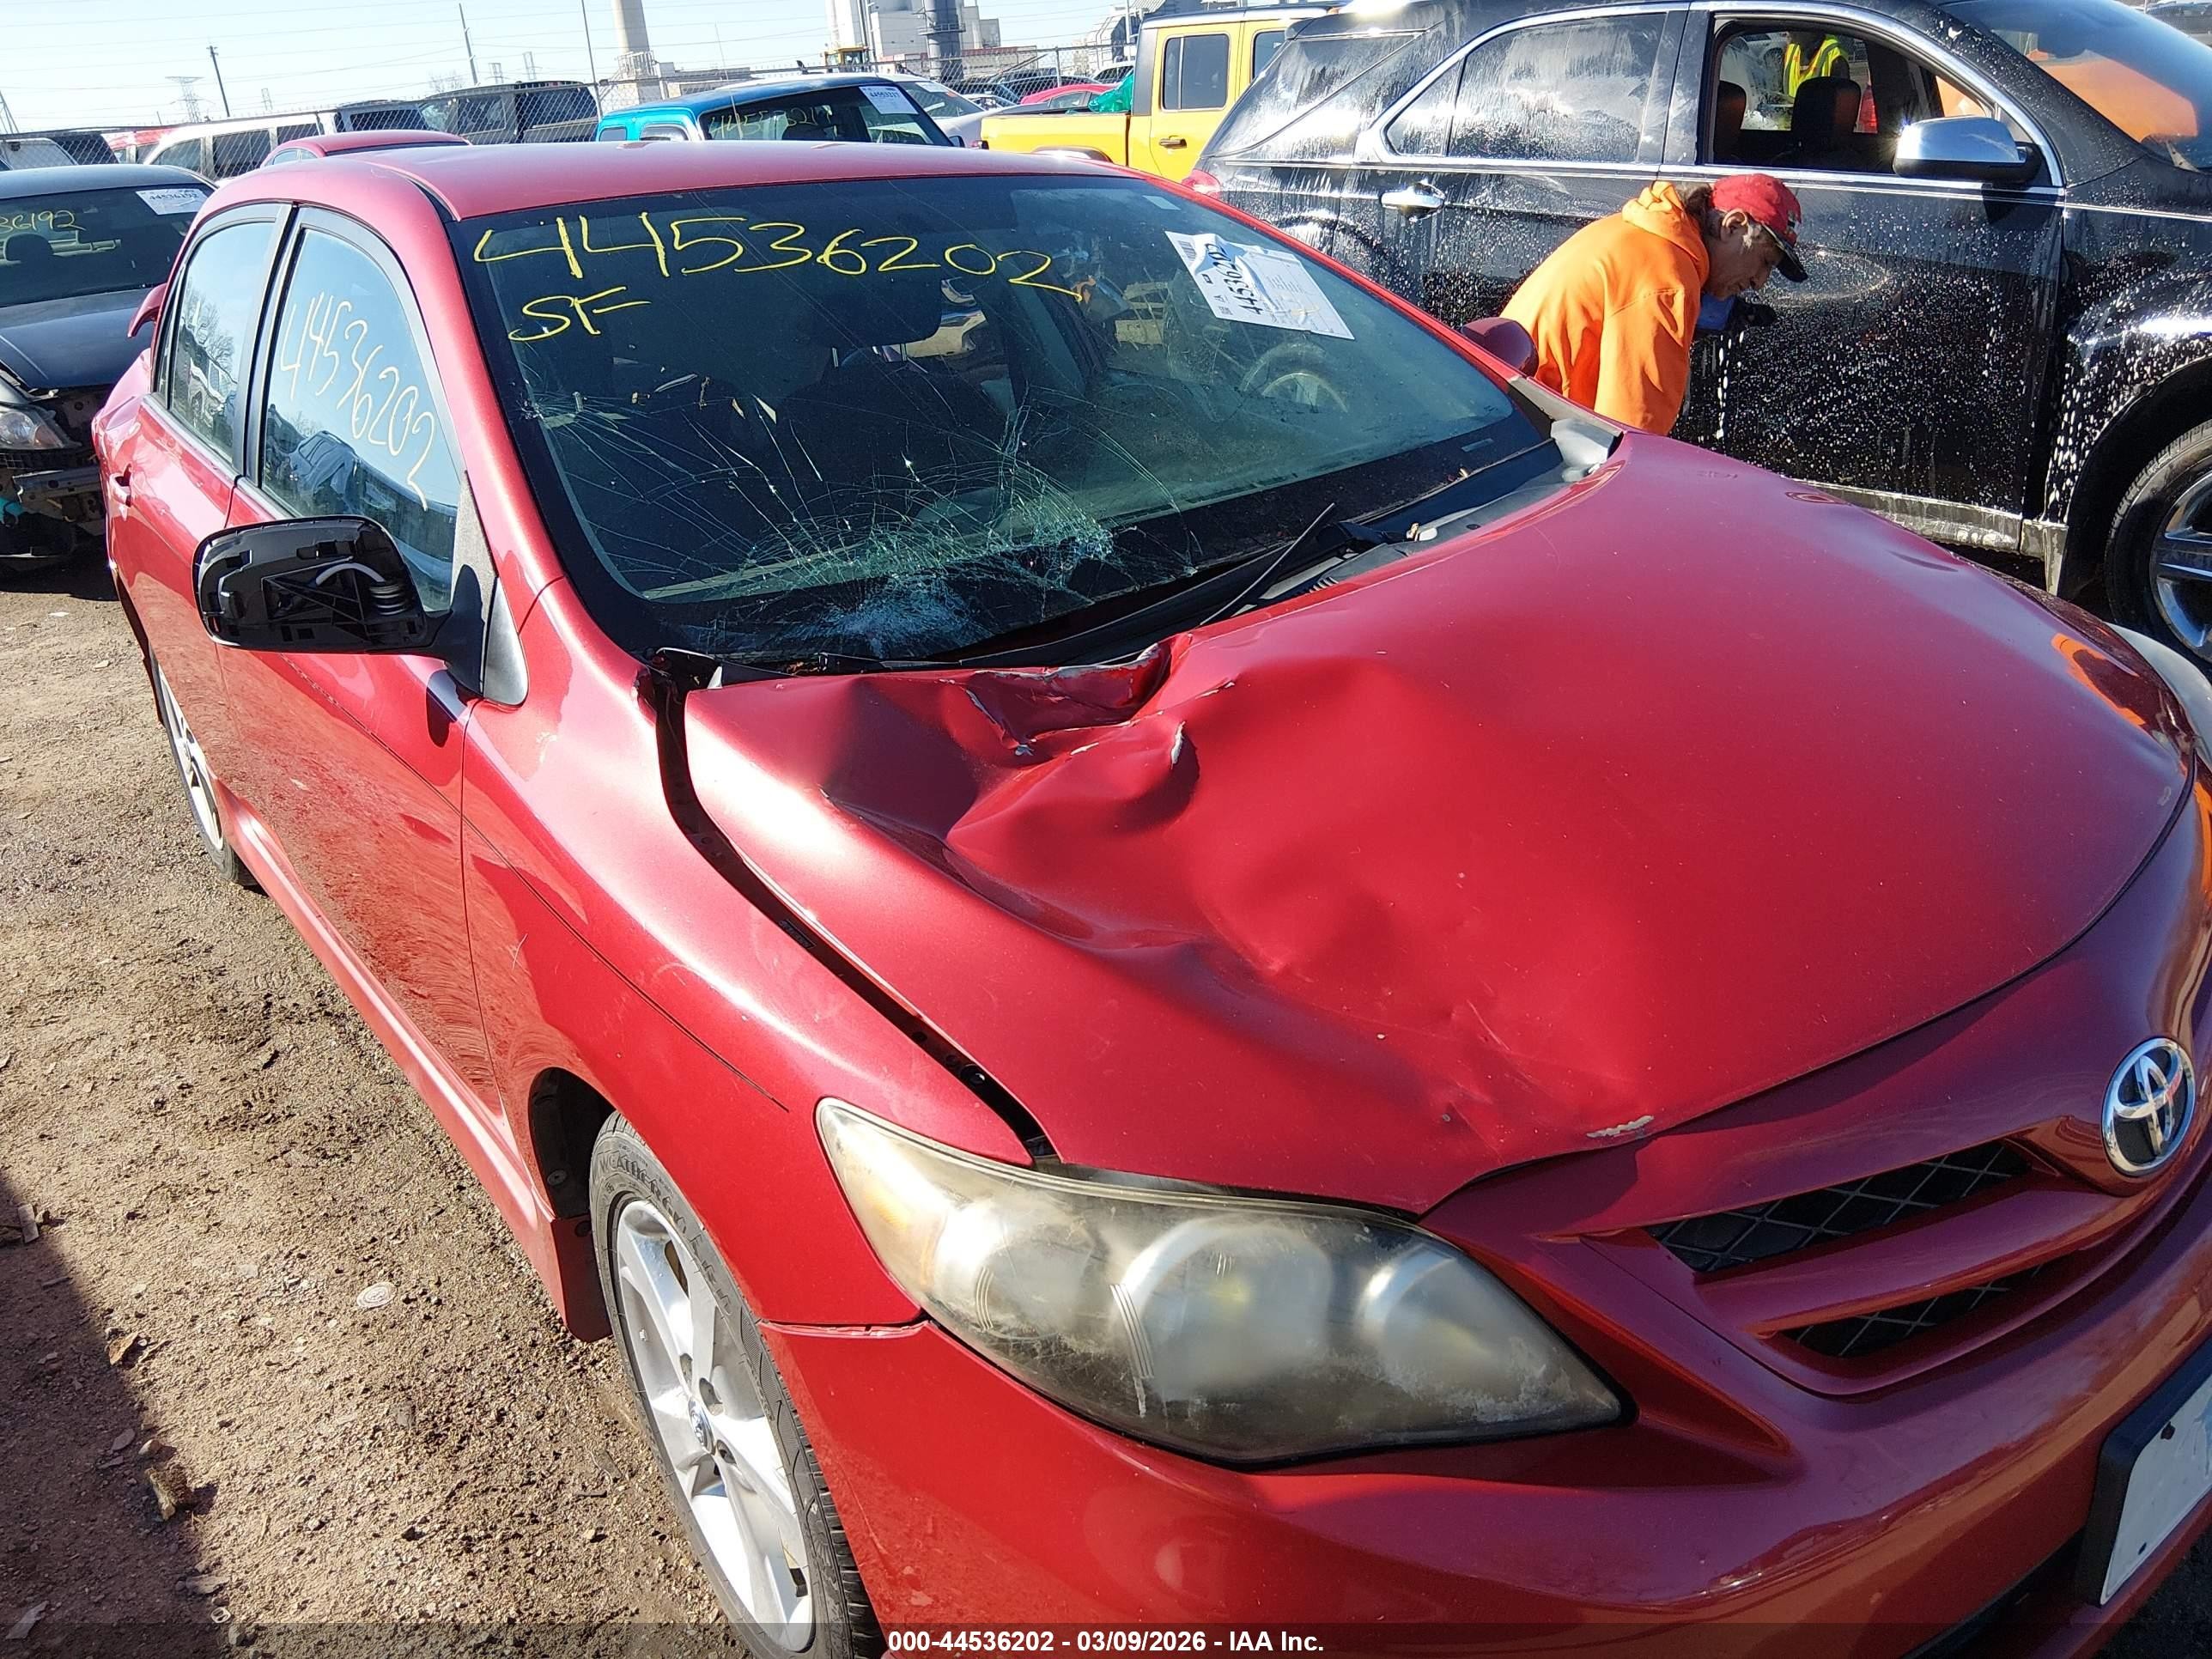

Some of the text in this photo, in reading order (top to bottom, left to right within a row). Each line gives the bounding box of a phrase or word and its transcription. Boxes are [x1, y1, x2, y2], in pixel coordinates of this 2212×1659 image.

[473, 212, 1083, 301] 44536202
[507, 286, 652, 342] SF
[280, 291, 435, 511] 44536202
